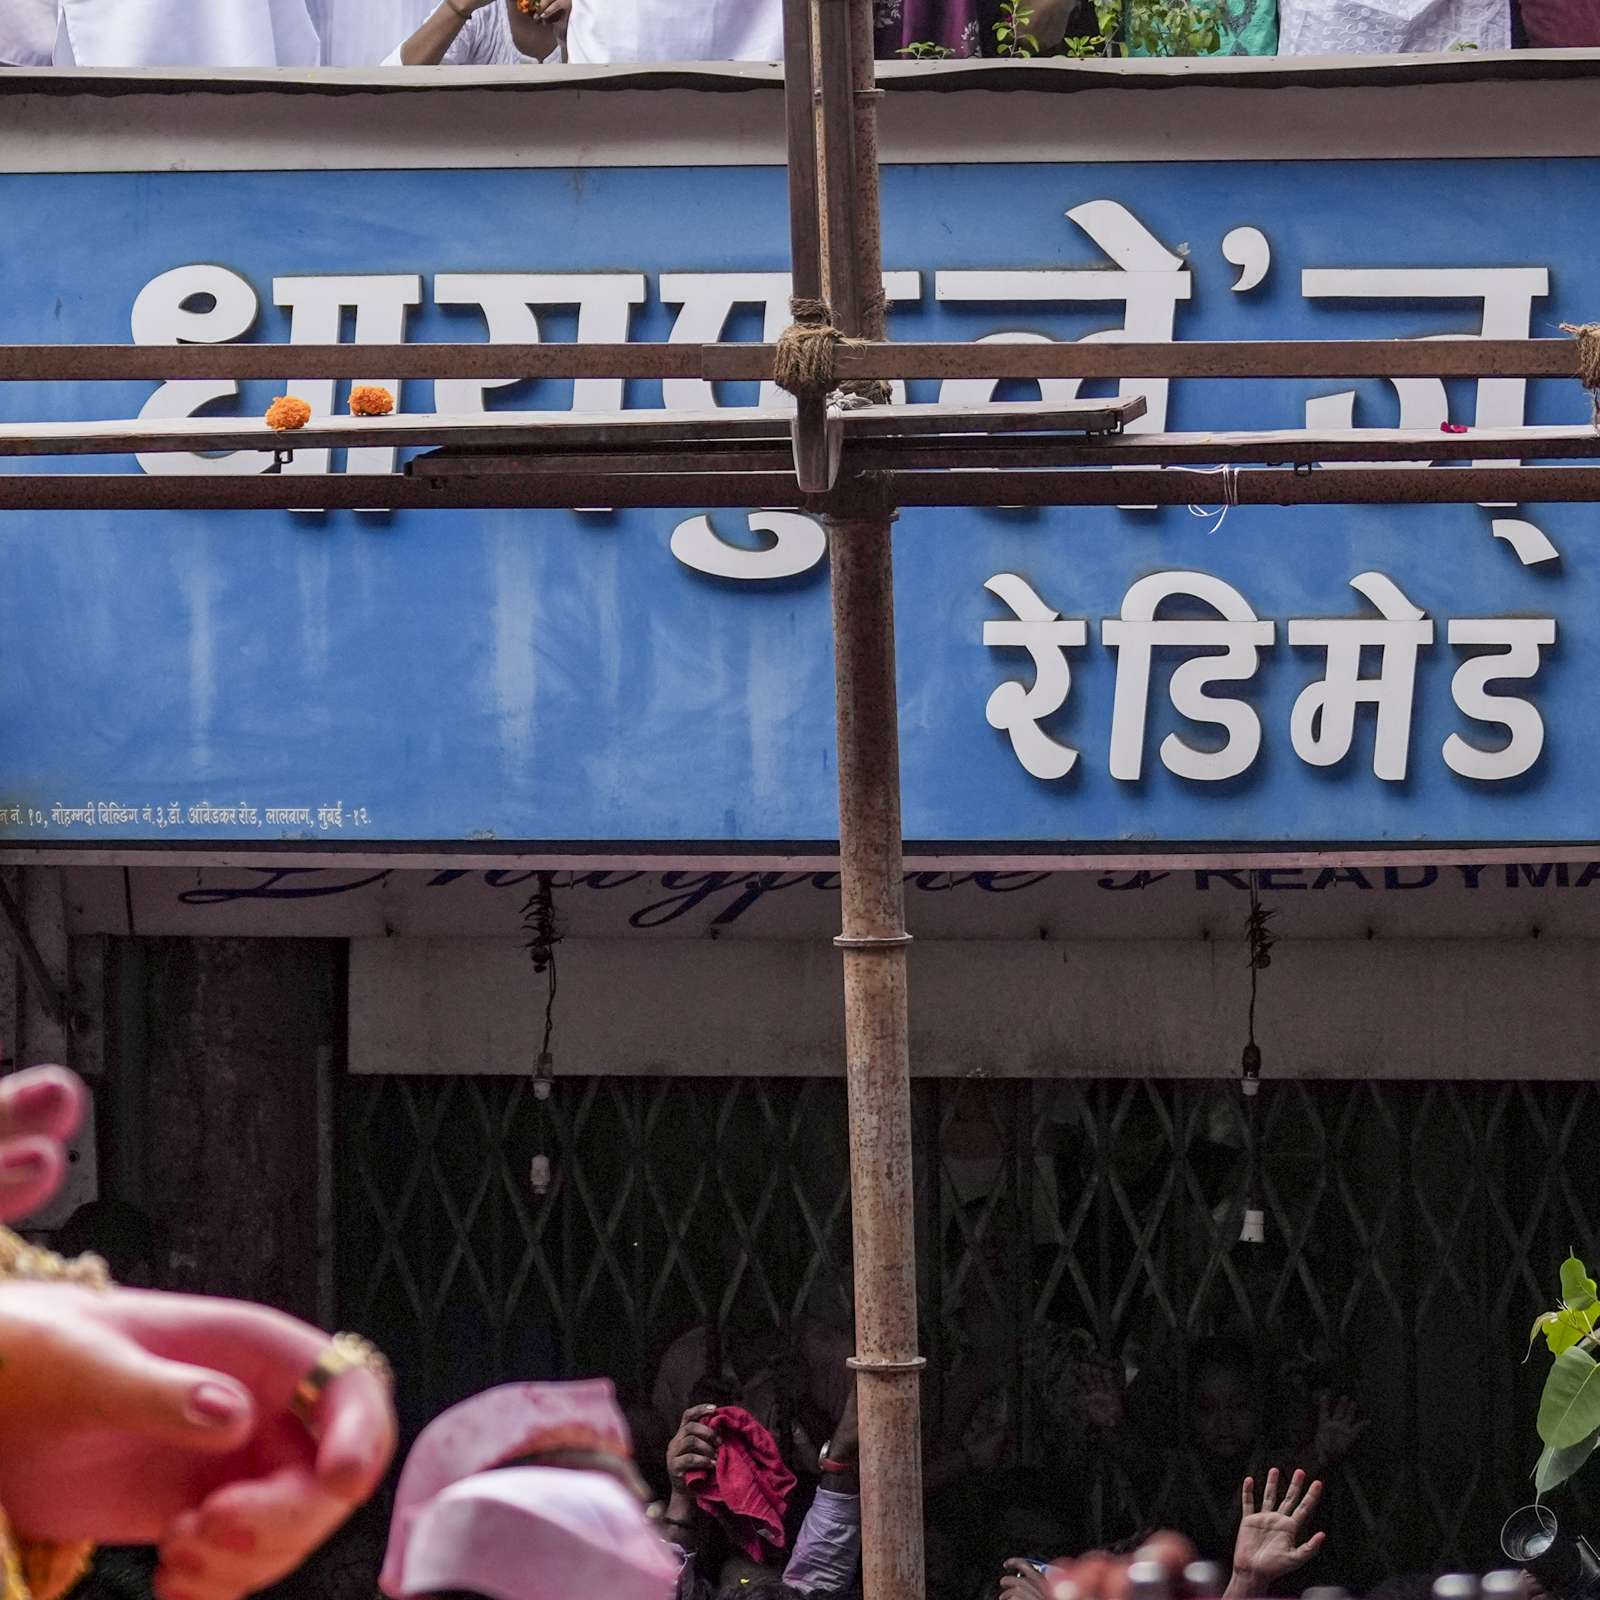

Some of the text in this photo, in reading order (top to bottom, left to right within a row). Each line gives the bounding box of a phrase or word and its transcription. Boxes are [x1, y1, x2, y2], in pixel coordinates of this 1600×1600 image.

[983, 570, 1556, 780] रेडिमेड
[51, 802, 97, 827] मोहम्मदी
[98, 802, 138, 825] बिल्डिंग
[188, 802, 237, 825] आंबेडकर
[238, 802, 262, 828] रोड,
[265, 807, 314, 828] लालबाग,
